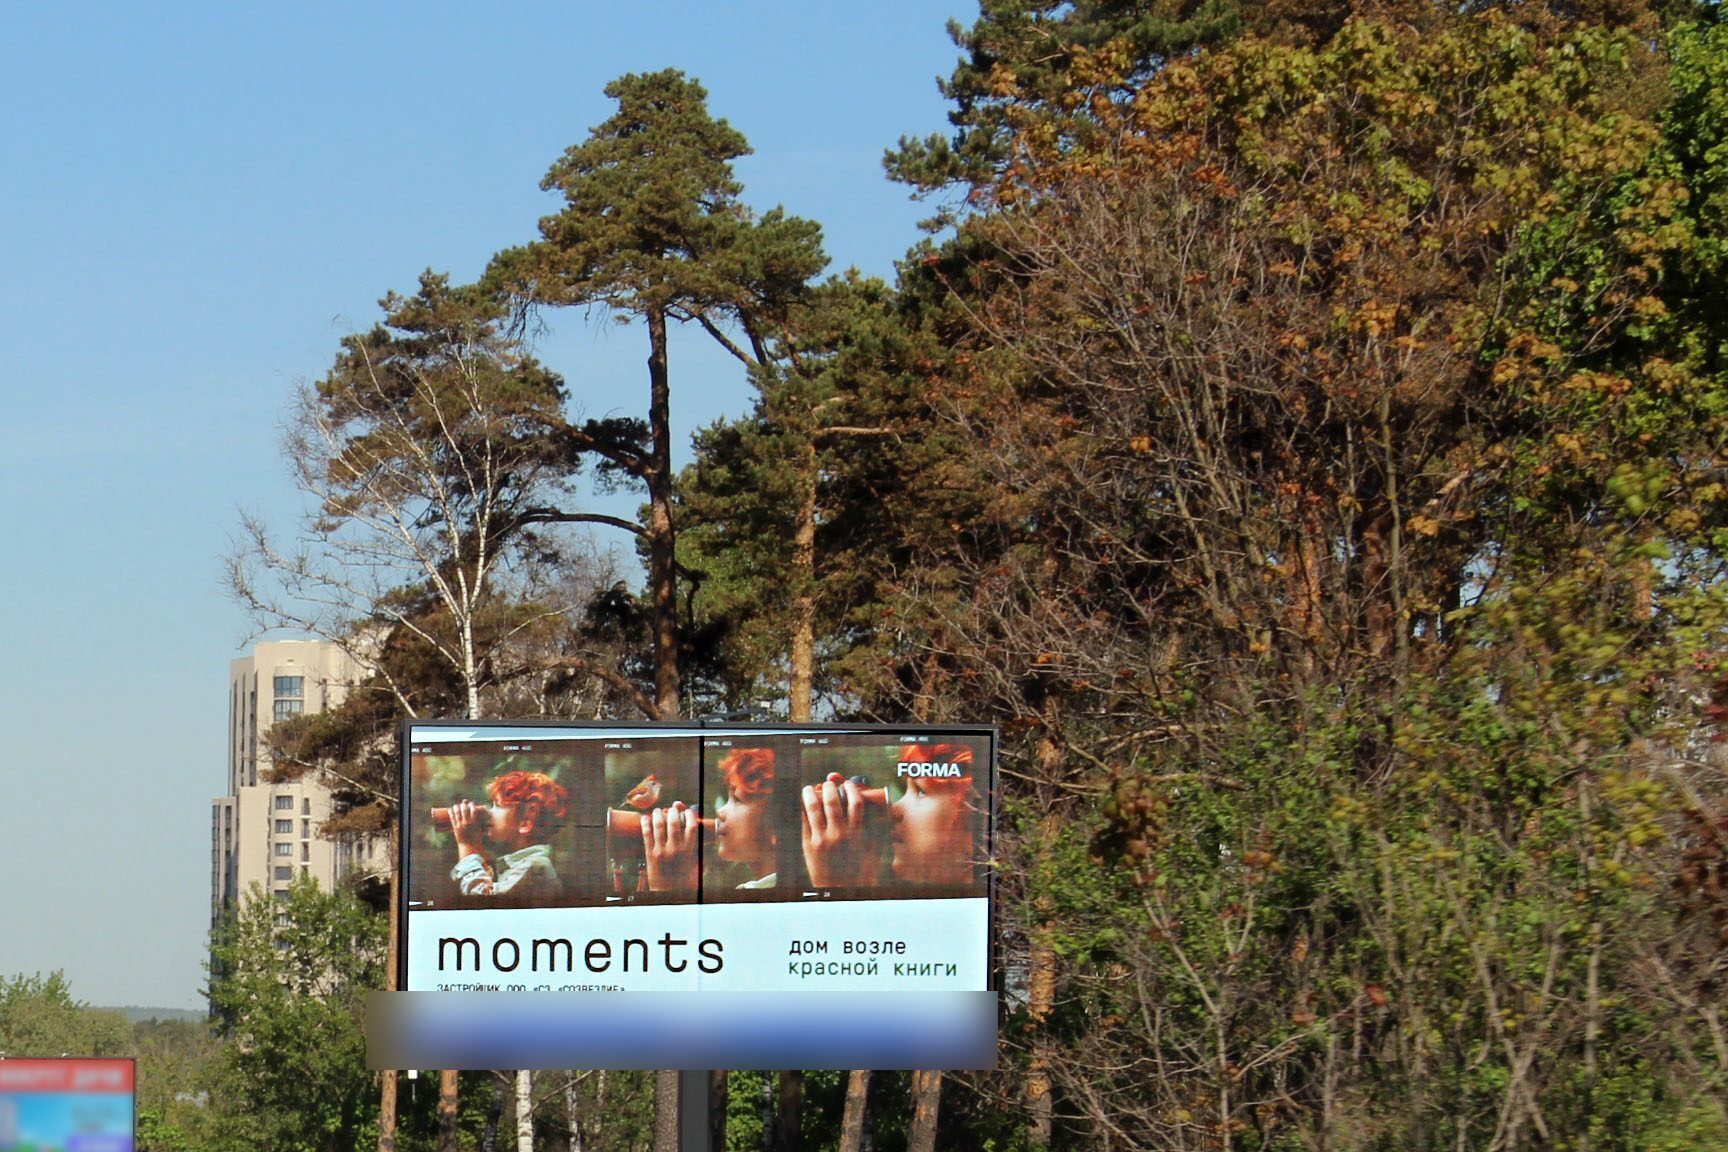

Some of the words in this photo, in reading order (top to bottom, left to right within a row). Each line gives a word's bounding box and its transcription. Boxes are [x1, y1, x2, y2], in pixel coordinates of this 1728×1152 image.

[897, 762, 962, 777] FORMA
[438, 932, 724, 974] moments
[789, 940, 828, 955] дом
[843, 940, 907, 955] возле
[788, 958, 879, 979] красной
[893, 962, 958, 976] книги
